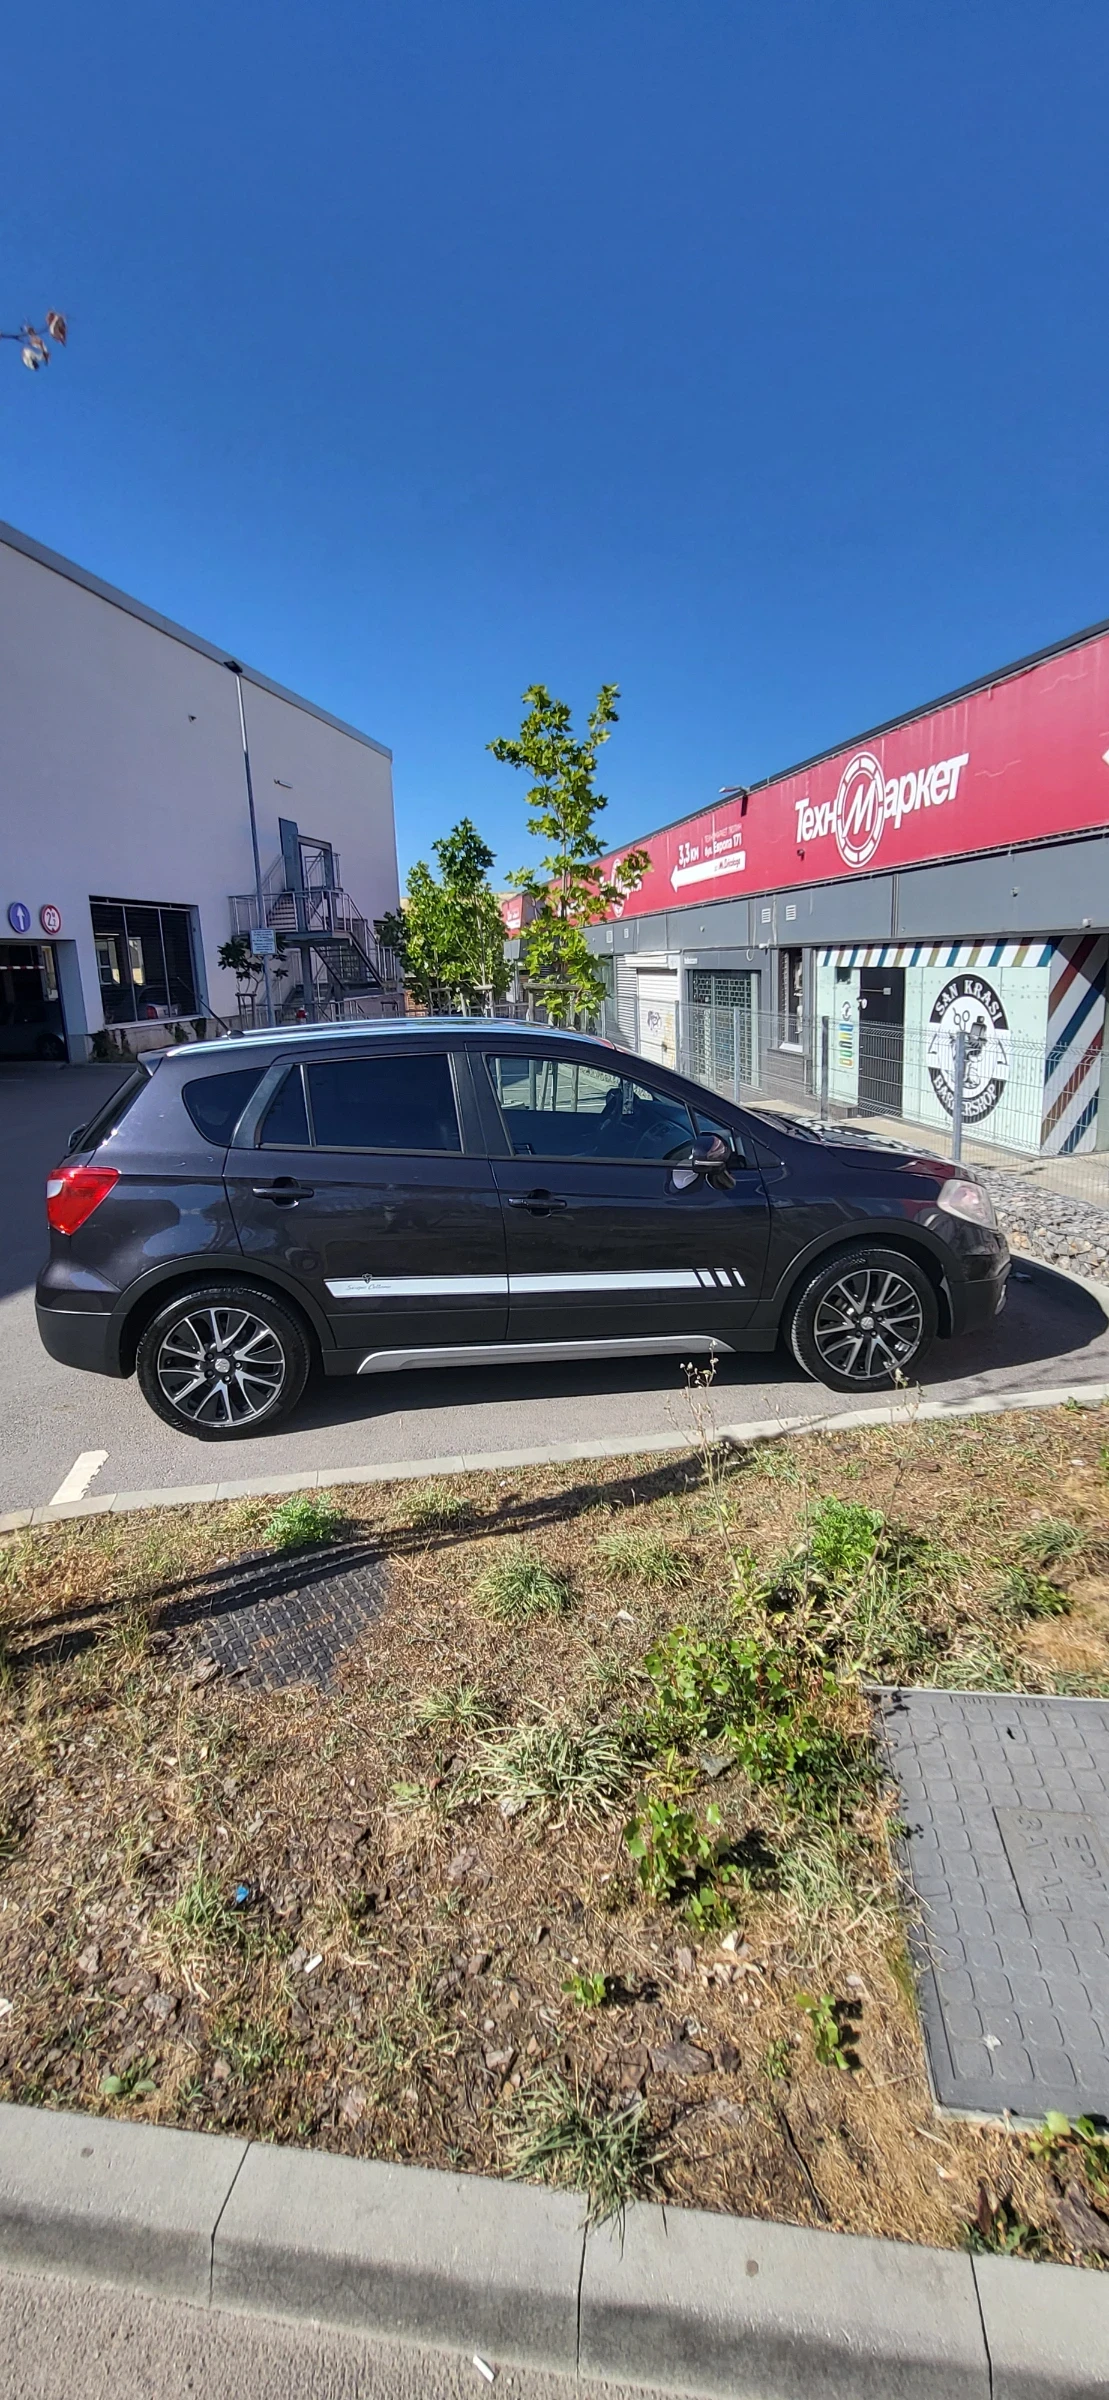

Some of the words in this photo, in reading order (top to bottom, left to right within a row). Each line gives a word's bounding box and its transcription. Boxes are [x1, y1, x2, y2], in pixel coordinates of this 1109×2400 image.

[714, 837, 733, 855] Европа
[935, 983, 959, 1017] SAN
[964, 979, 1003, 1024] KRASI
[943, 1074, 997, 1117] BARRSHOP
